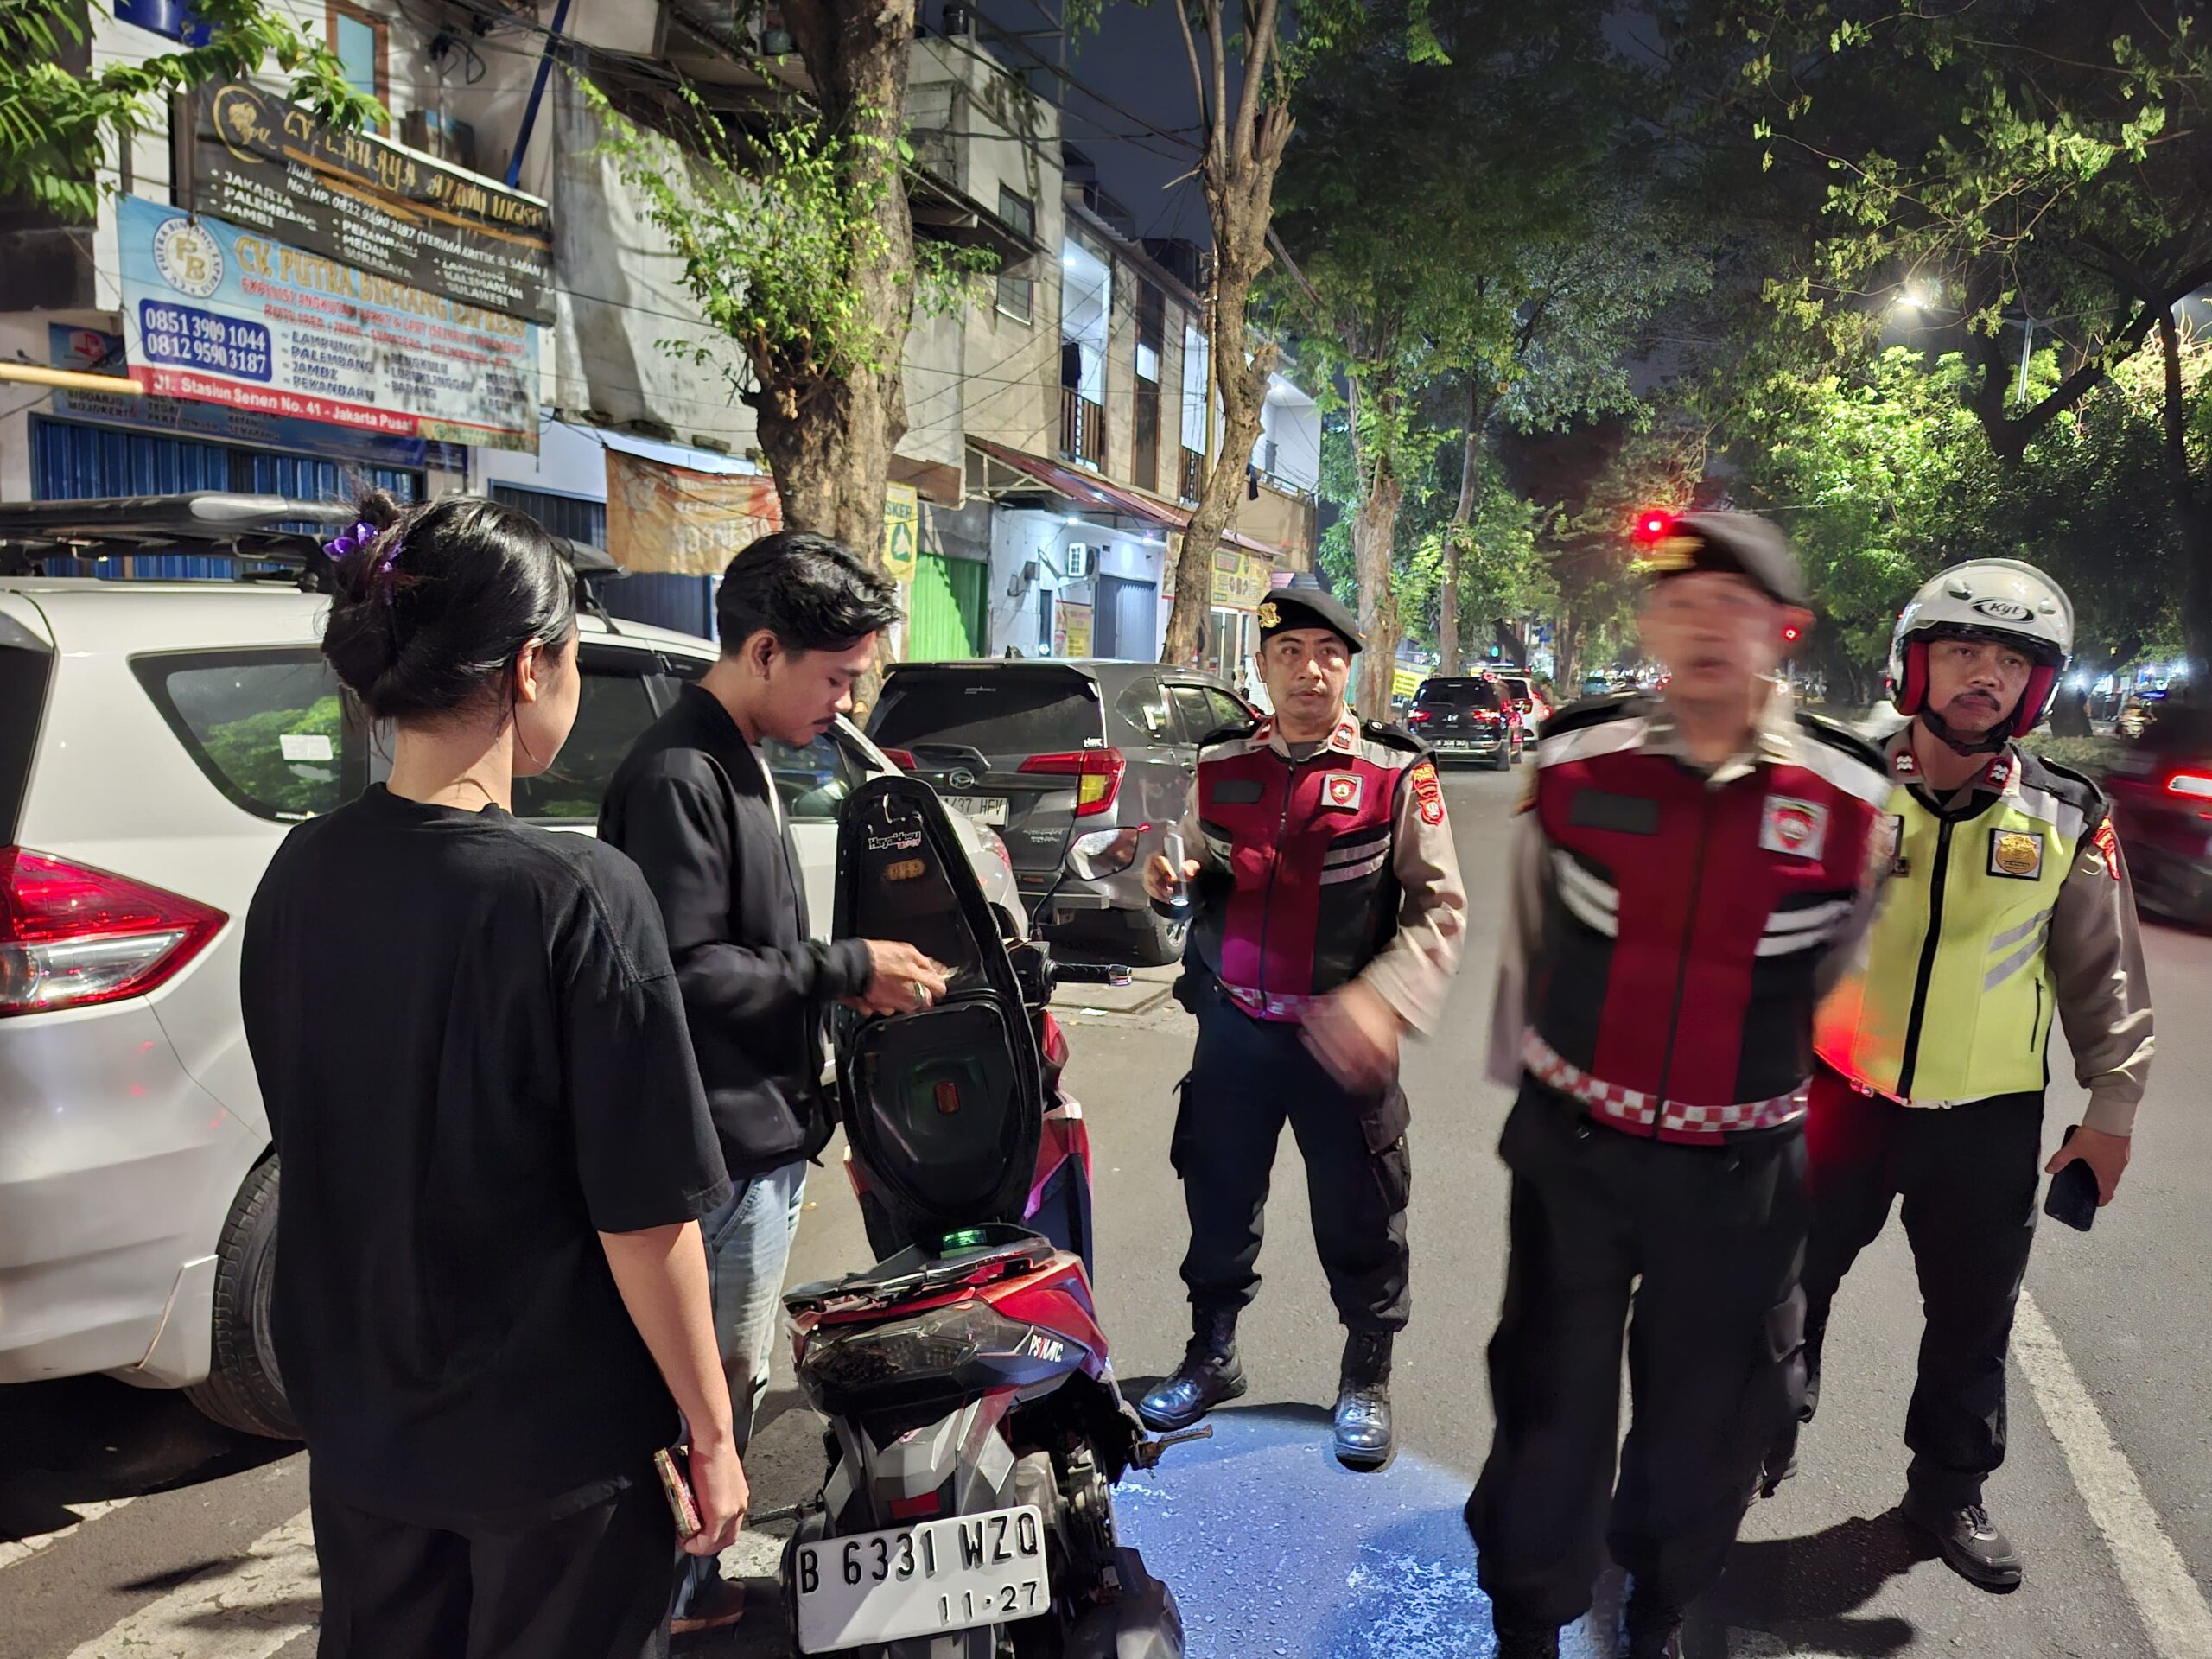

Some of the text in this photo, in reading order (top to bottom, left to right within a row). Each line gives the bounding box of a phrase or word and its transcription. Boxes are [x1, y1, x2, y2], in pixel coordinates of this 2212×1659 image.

[223, 171, 294, 208] JAKARTA
[287, 178, 308, 196] No.
[310, 187, 330, 205] HP.
[332, 196, 361, 217] 0812
[222, 202, 275, 228] JAMBI
[224, 186, 318, 232] PALEMBANG
[342, 234, 389, 259] MEDAN
[236, 237, 272, 277] CV.
[280, 248, 355, 296] PUTRA
[145, 308, 265, 352] 0851 3909 1044
[292, 331, 359, 357] LAMPUNG
[147, 334, 266, 373] 0812 9590 3187
[291, 346, 374, 374] PALEMBANG
[292, 361, 338, 380] JAMBI
[181, 377, 232, 400] Stasiun
[234, 388, 277, 409] Senen
[281, 396, 304, 412] No.
[307, 401, 321, 416] 41
[333, 405, 377, 426] Jakarta
[293, 376, 375, 402] PEKANBARU
[800, 1513, 1039, 1594] B 6331 WZQ
